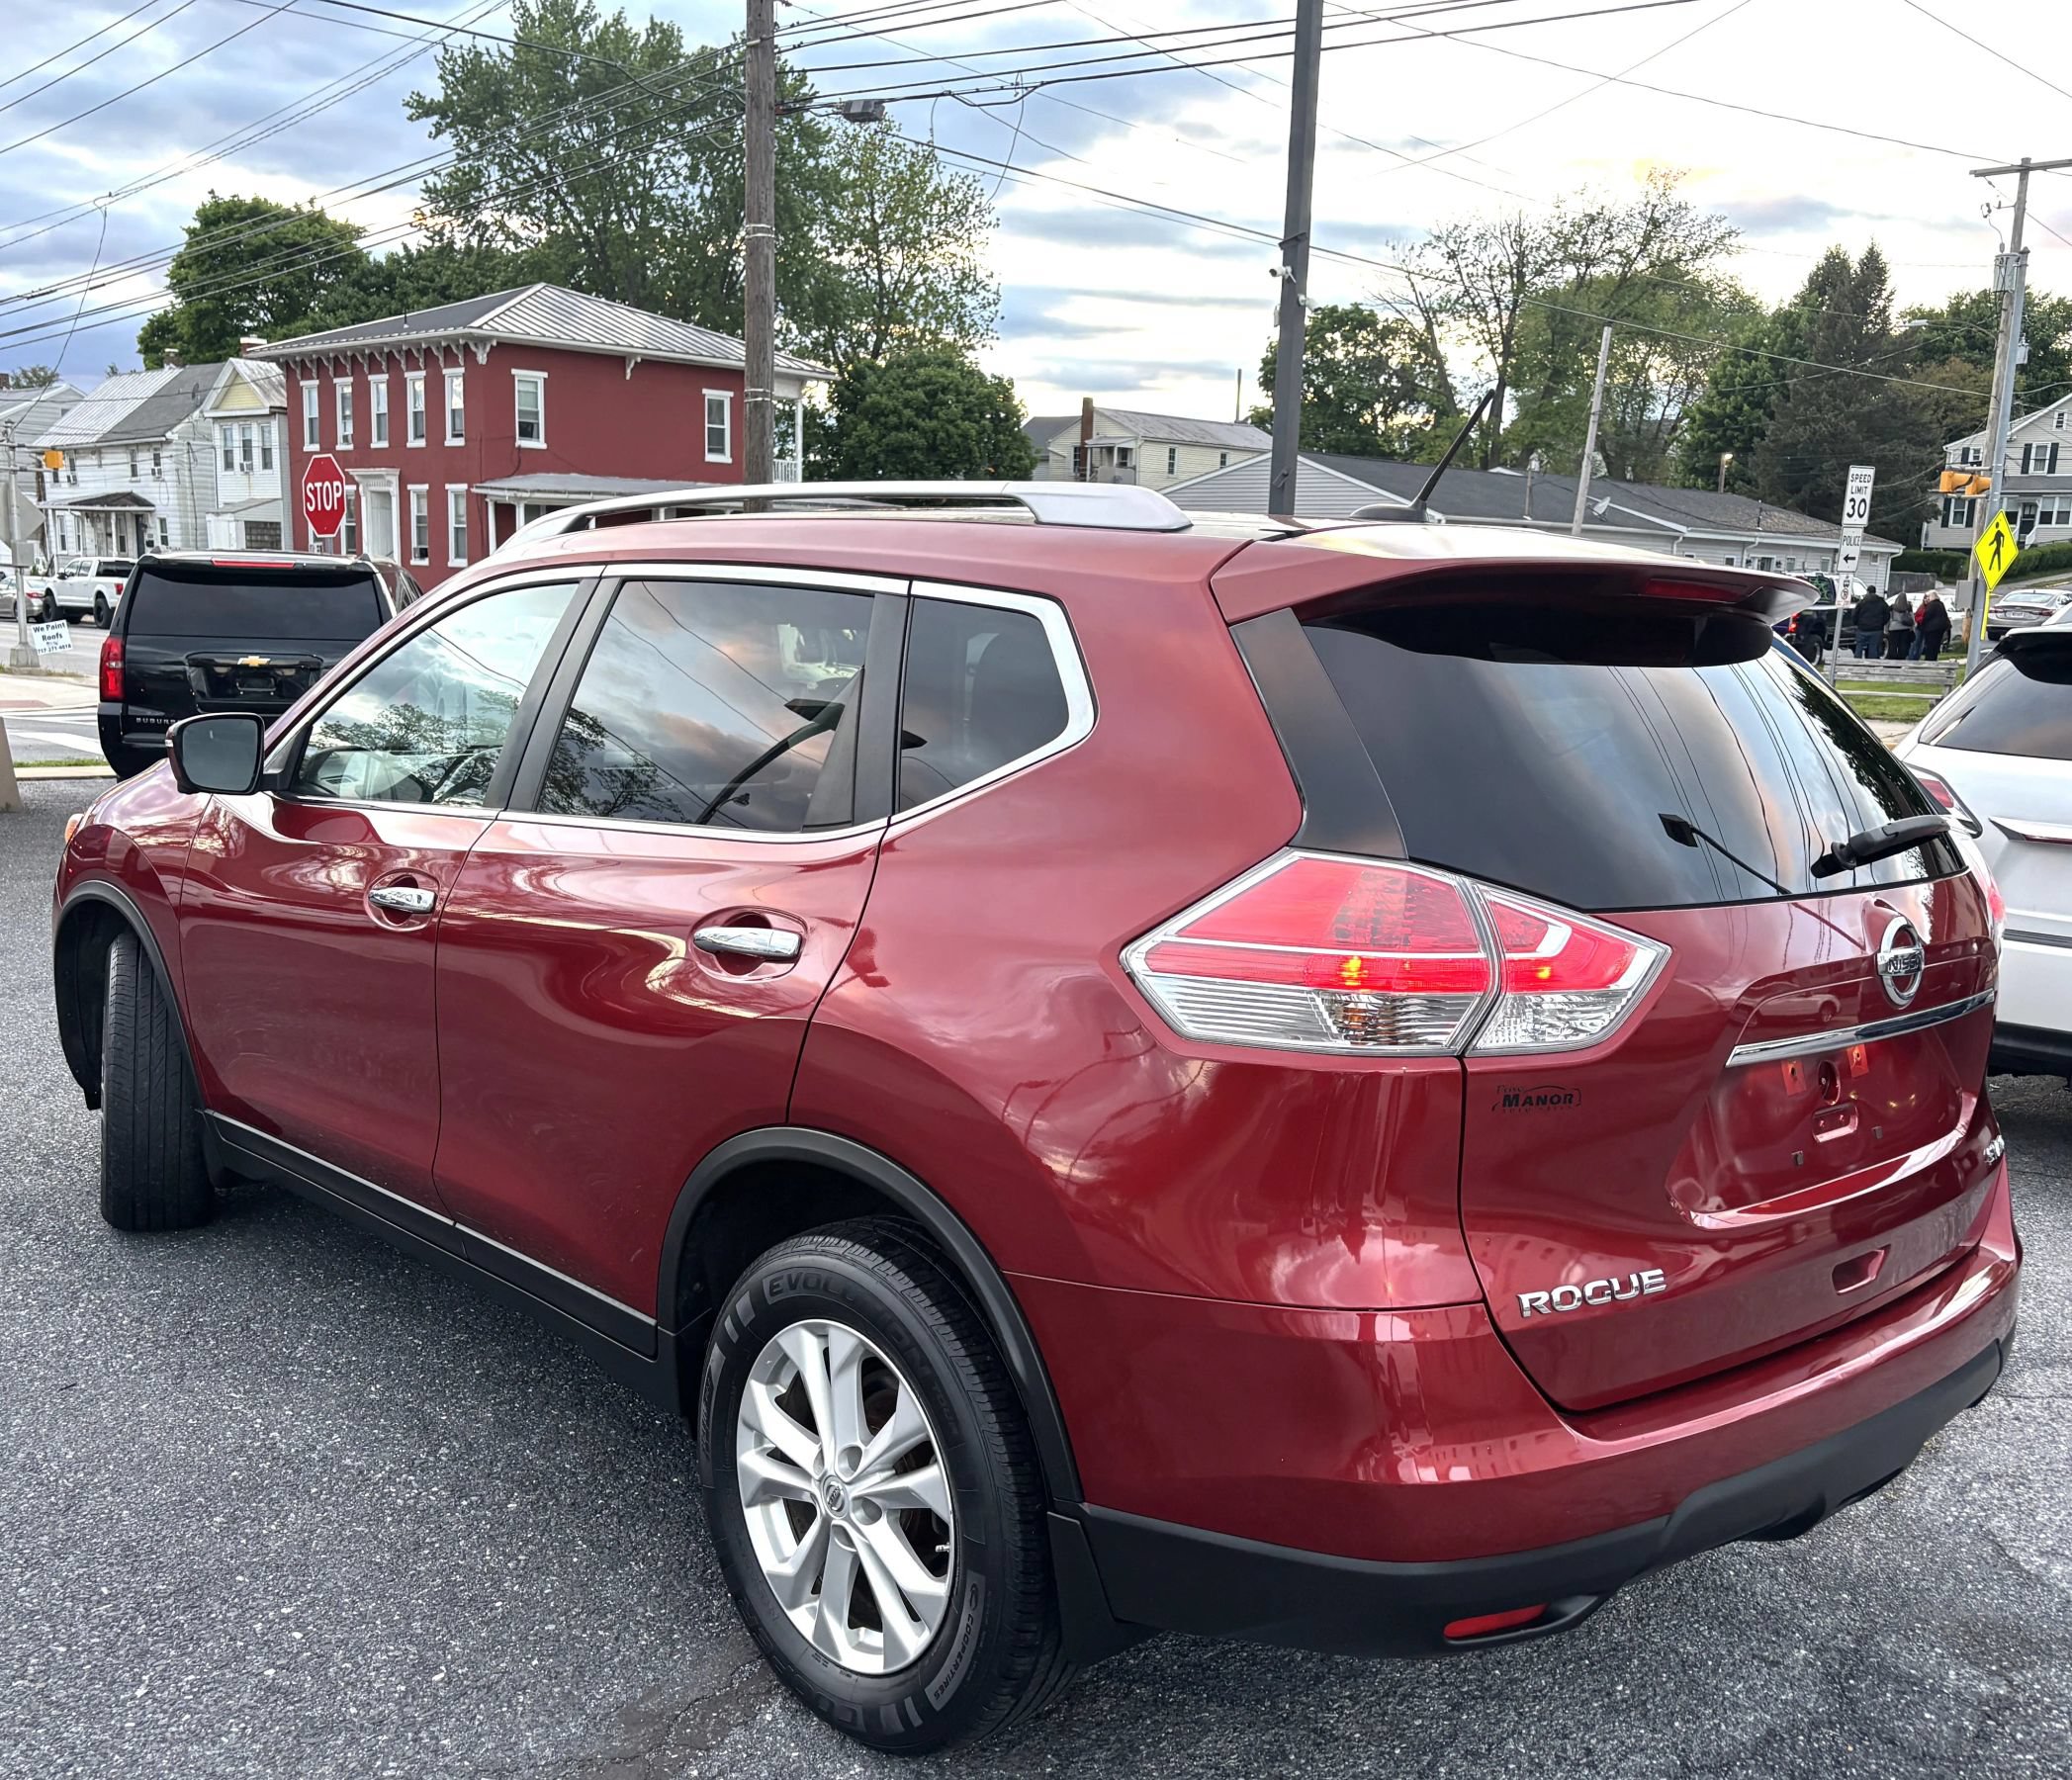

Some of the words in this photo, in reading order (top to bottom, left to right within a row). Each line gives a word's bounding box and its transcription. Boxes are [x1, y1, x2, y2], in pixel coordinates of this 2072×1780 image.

[1850, 474, 1872, 484] SPEED
[1850, 486, 1868, 494] LIMIT
[306, 481, 342, 512] STOP
[1847, 496, 1867, 519] 30
[1842, 535, 1860, 547] POLICE
[45, 621, 66, 632] Paint
[42, 632, 63, 642] Roofs
[1502, 1093, 1575, 1109] MANOR
[1517, 1268, 1667, 1318] ROGUE
